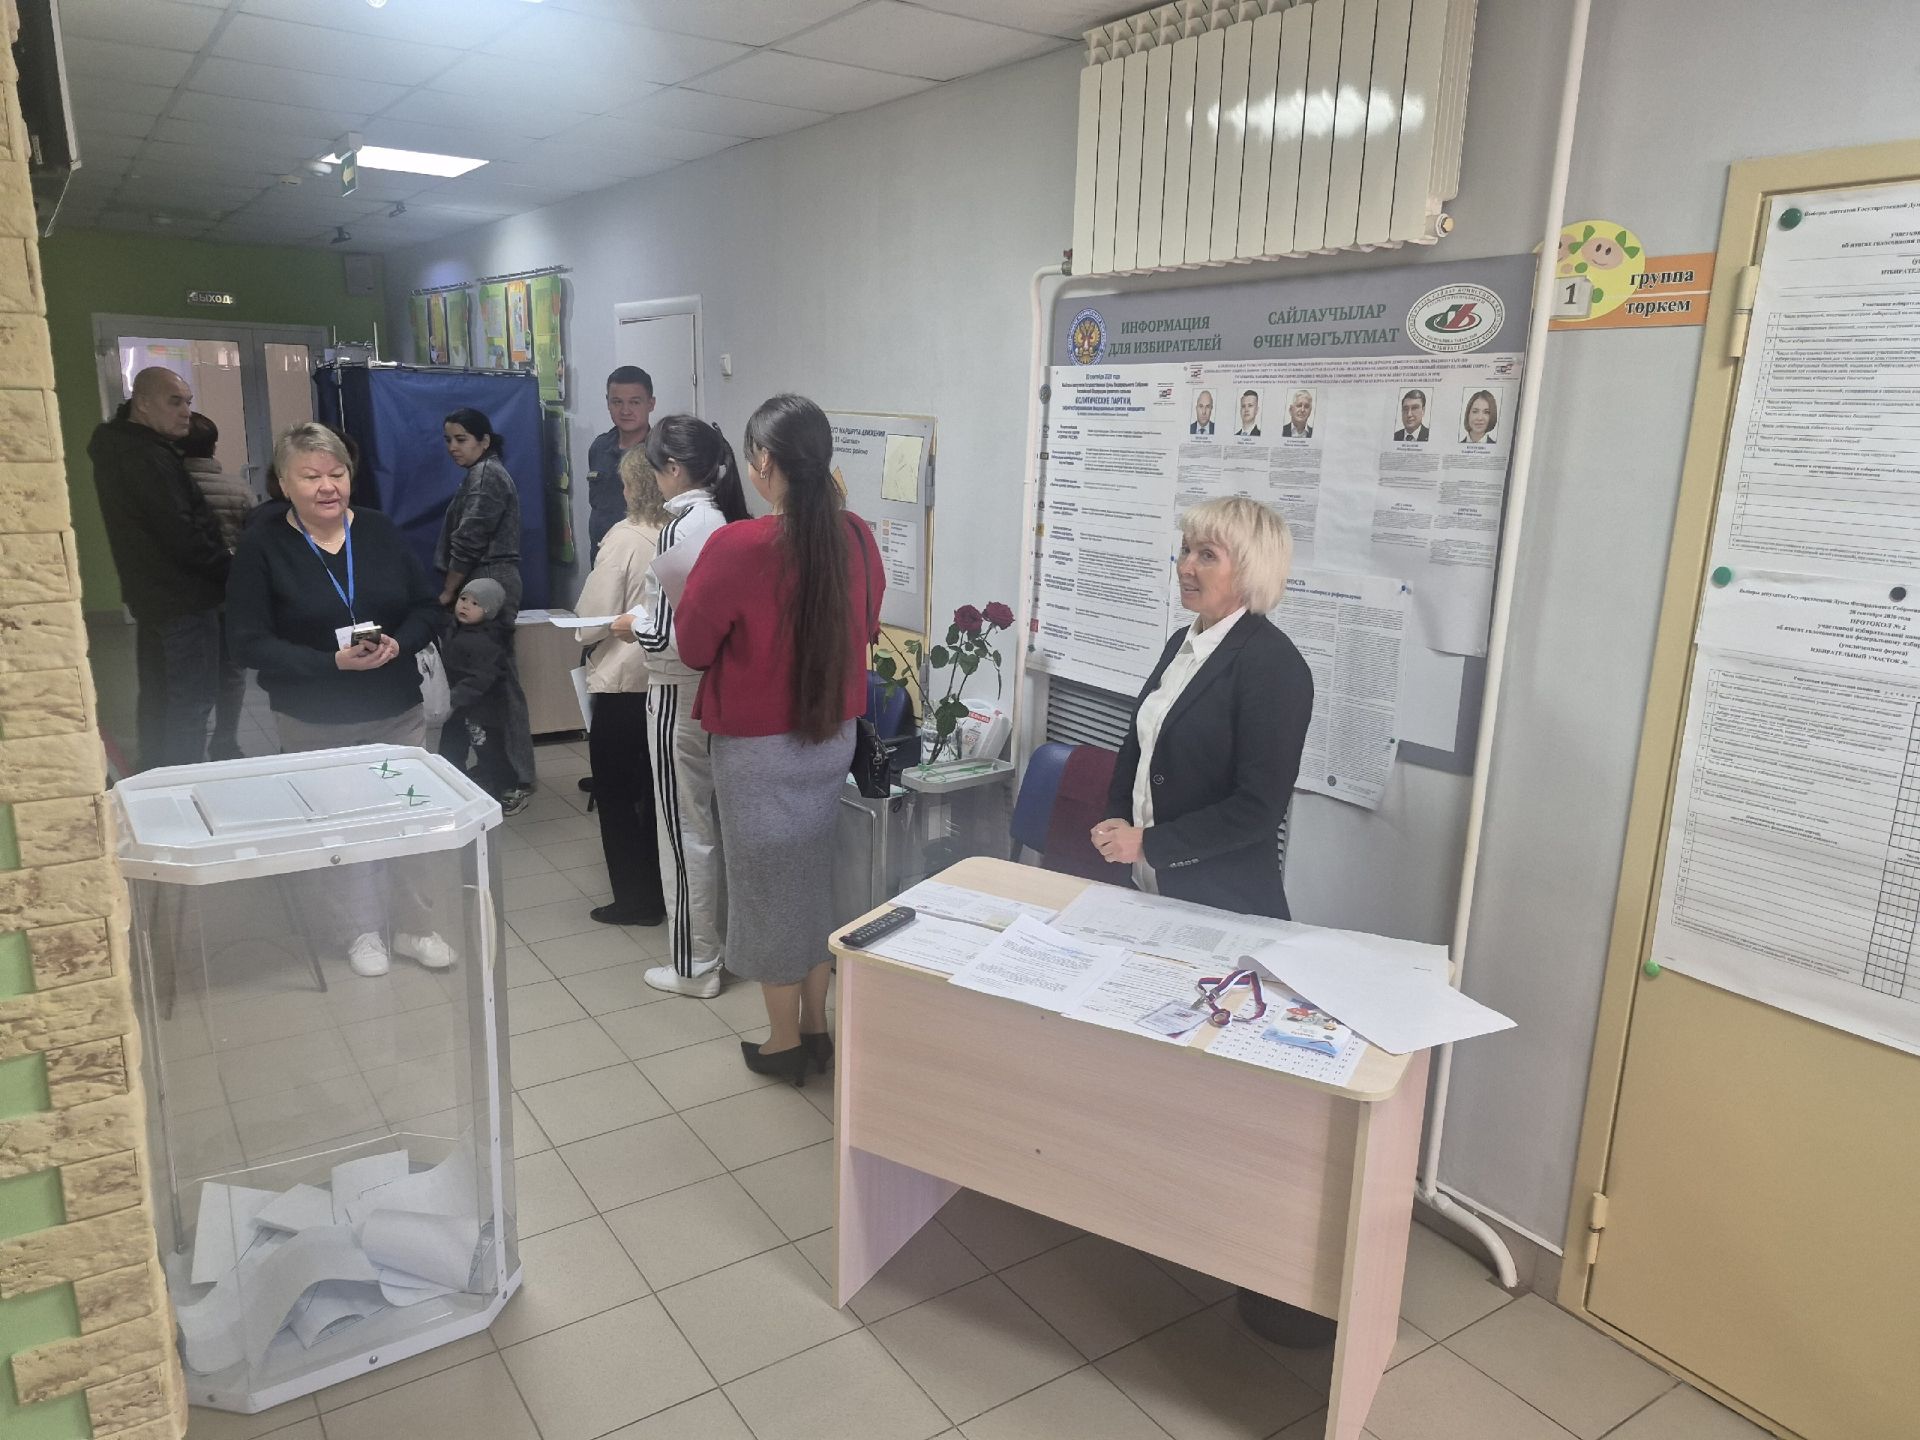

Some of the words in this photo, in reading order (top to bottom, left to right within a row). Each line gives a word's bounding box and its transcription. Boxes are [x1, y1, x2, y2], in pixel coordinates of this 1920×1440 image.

[1630, 270, 1694, 289] группа
[1564, 283, 1577, 305] 1
[1267, 303, 1387, 326] САЙЛАУЧЫЛАР
[1626, 299, 1691, 317] төркем
[1121, 315, 1210, 335] ИНФОРМАЦИЯ
[1108, 341, 1131, 358] ДЛЯ
[1134, 333, 1222, 355] ИЗБИРАТЕЛЕЙ
[1253, 331, 1293, 349] ӨЧЕН
[1298, 326, 1400, 348] МӘГЪЛҮМАТ
[1850, 618, 1892, 629] ПРОТОКОЛ
